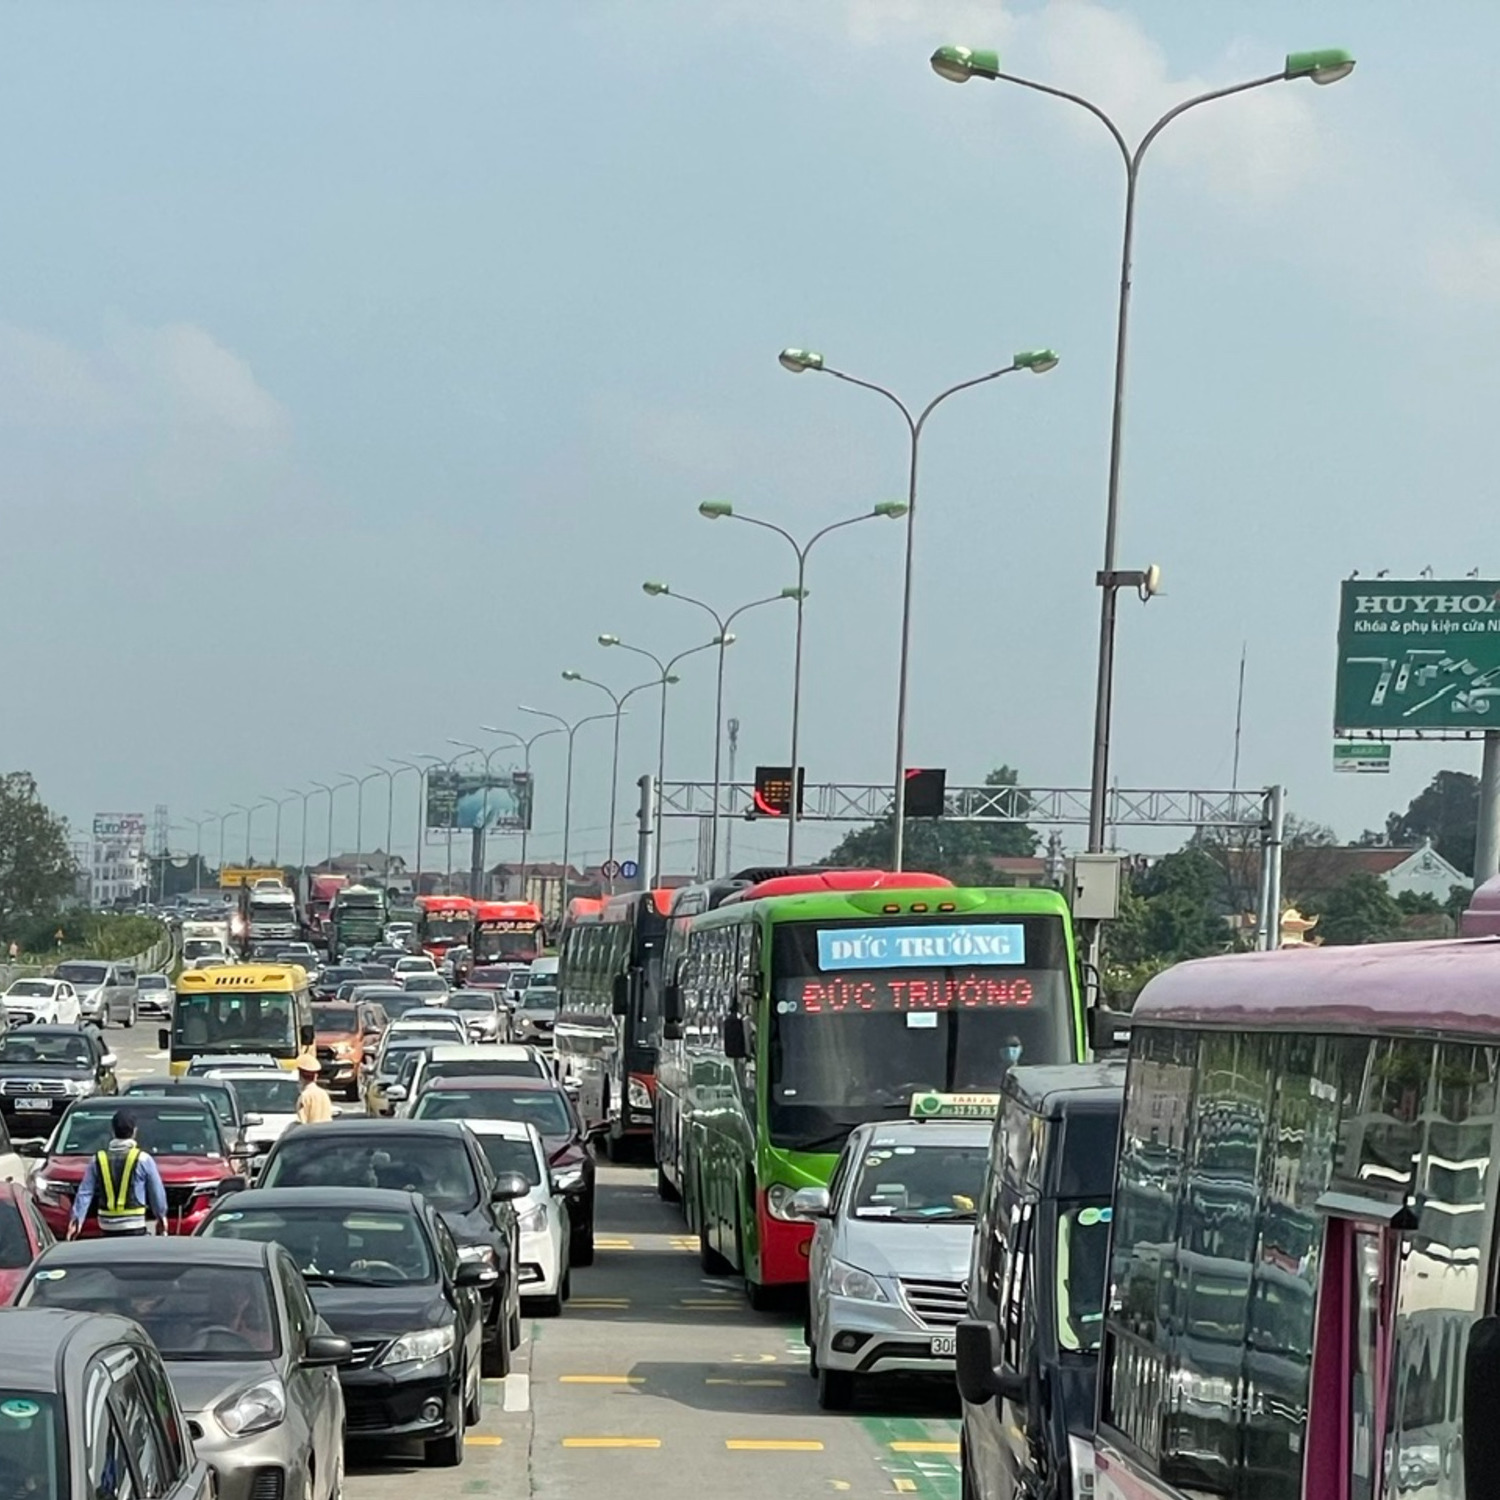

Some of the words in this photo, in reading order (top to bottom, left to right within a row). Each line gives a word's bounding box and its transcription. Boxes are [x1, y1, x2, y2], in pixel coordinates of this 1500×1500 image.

[1354, 620, 1388, 632] Khóa
[1390, 620, 1401, 632] &
[1403, 620, 1429, 635] phụ
[1431, 619, 1459, 635] kiện
